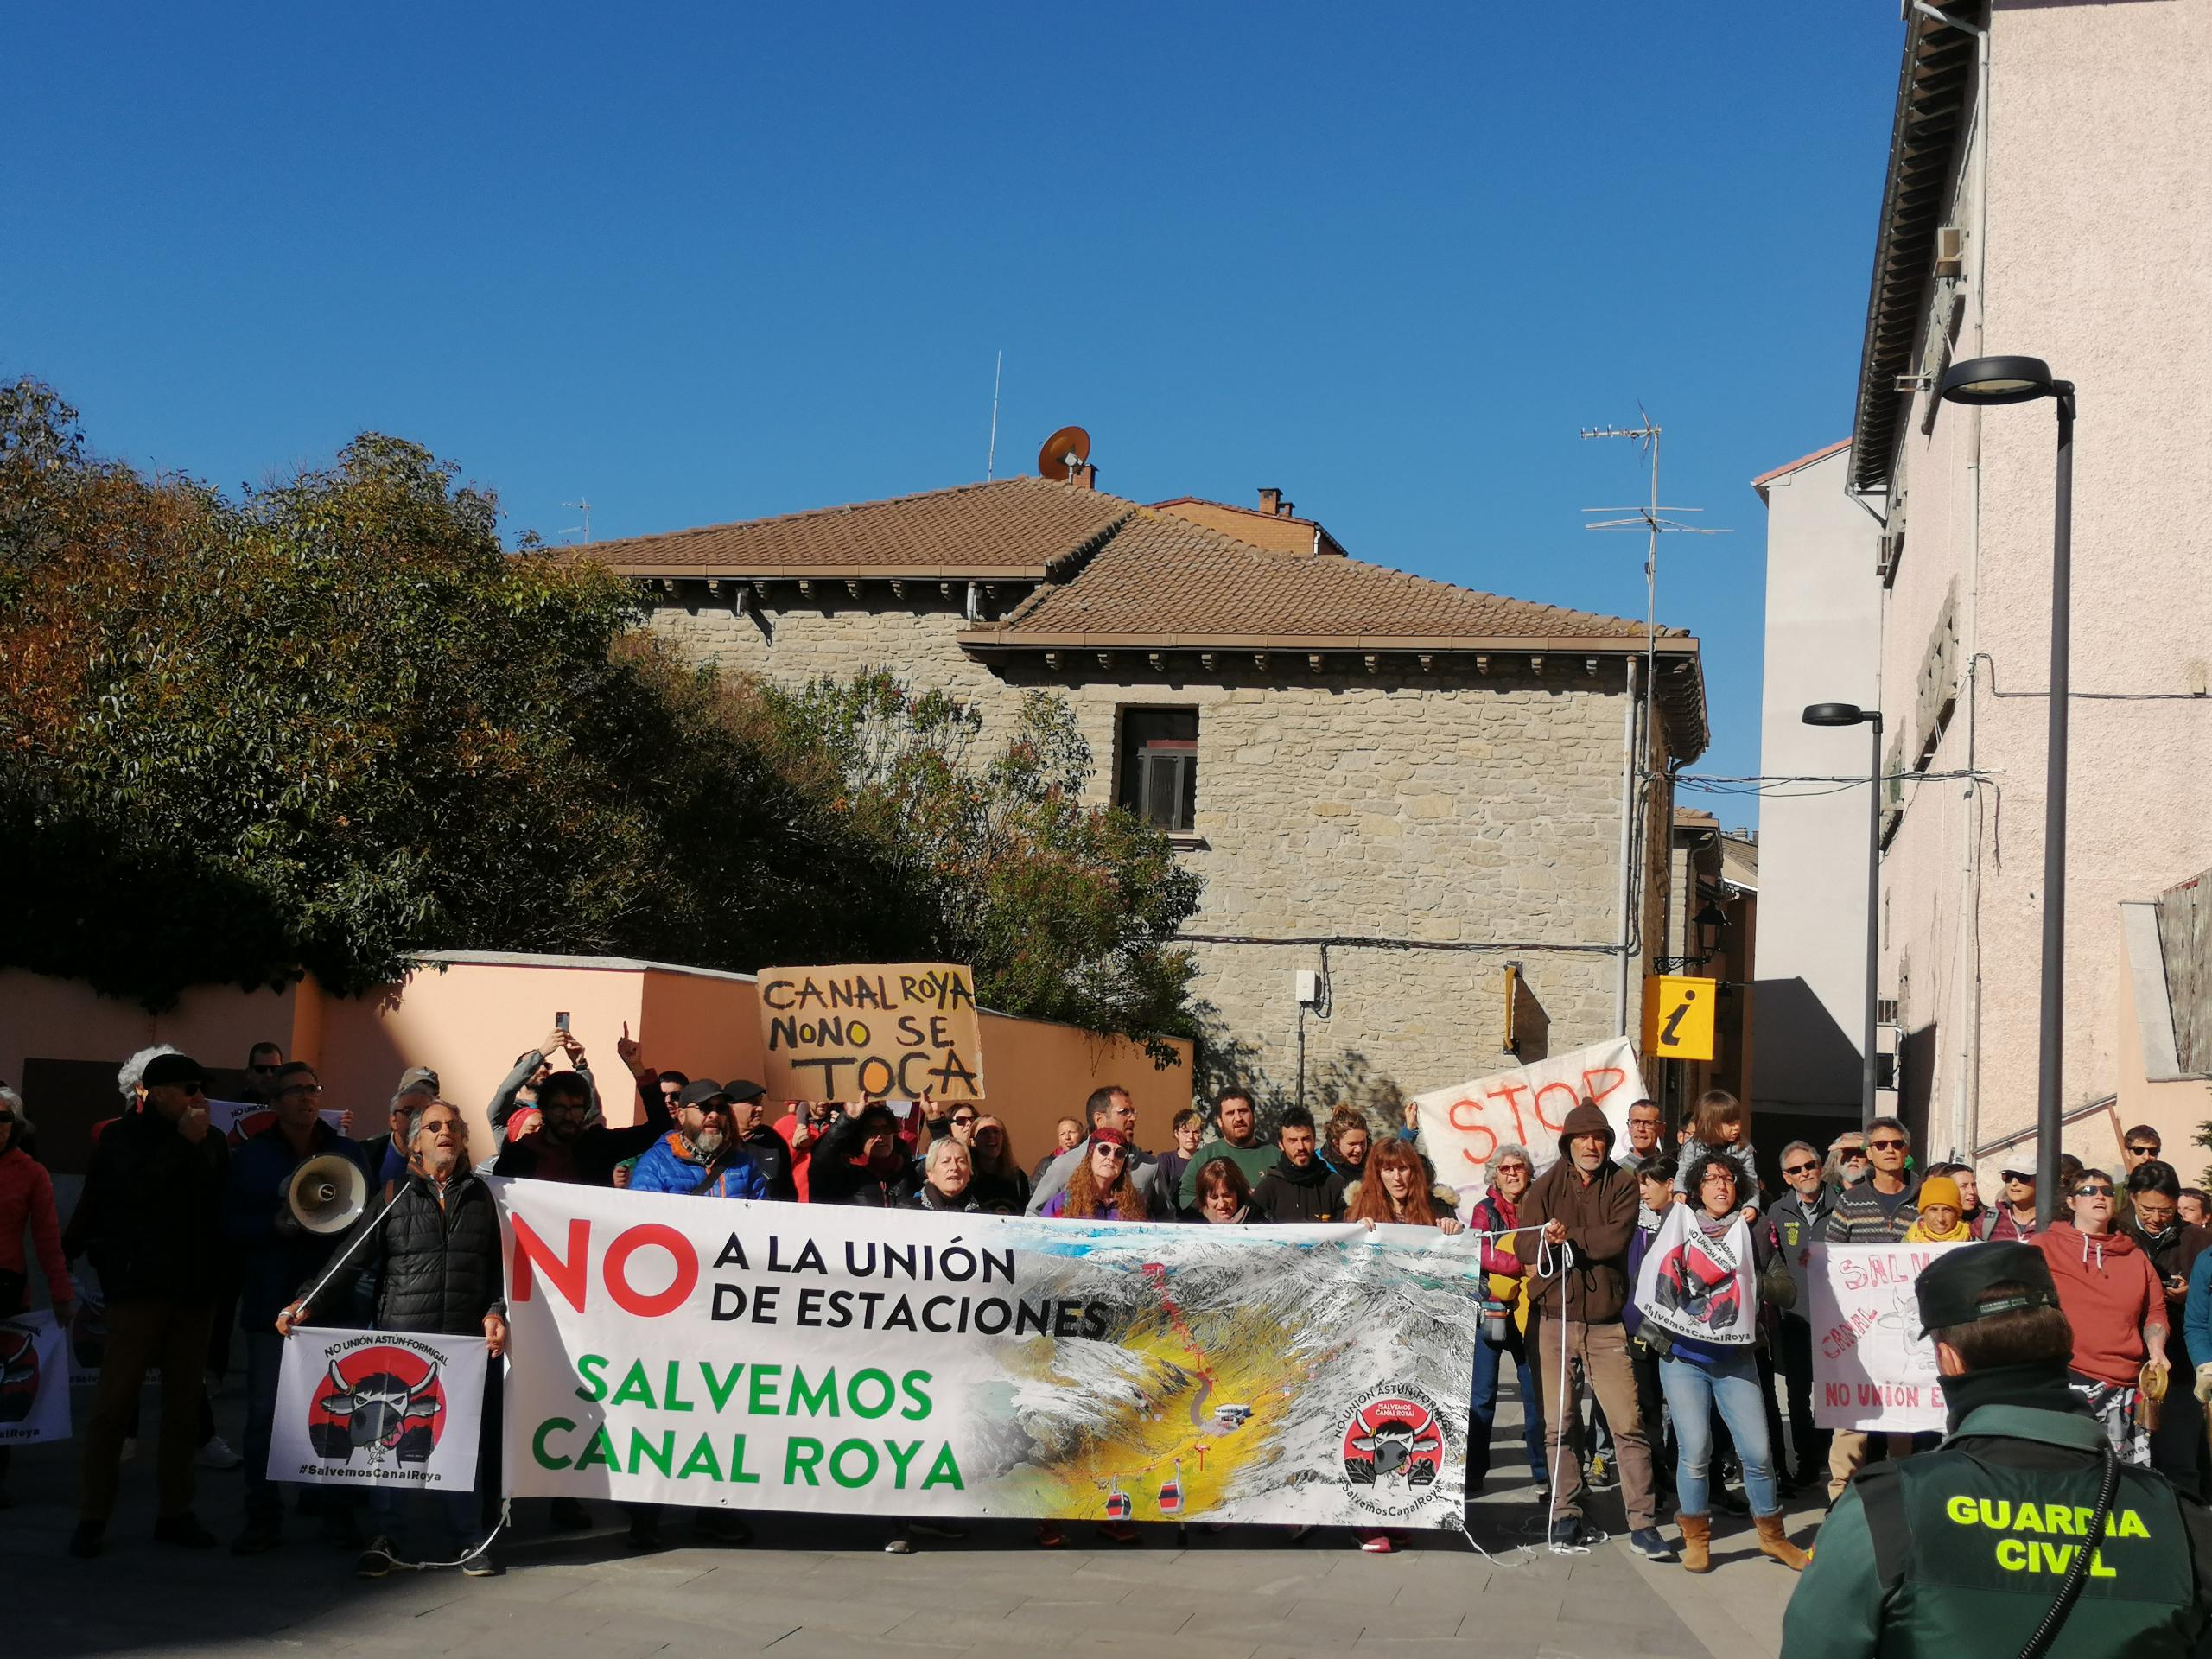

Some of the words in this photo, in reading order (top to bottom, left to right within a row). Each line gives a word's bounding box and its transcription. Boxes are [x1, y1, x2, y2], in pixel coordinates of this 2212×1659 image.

[764, 975, 898, 1010] CANAL
[899, 970, 976, 1010] ROYA
[896, 1015, 954, 1048] SE
[791, 1049, 978, 1100] TOCA
[1449, 1067, 1625, 1165] STOP
[512, 1212, 699, 1318] NO
[713, 1231, 750, 1270] A
[768, 1236, 829, 1275] LA
[845, 1236, 1016, 1285] UNIÓN
[711, 1282, 780, 1324] DE
[797, 1287, 1108, 1338] ESTACIONES
[1822, 1307, 1878, 1359] CANAL
[324, 1344, 341, 1359] NO
[343, 1334, 374, 1351] UNIÓN
[575, 1354, 933, 1421] SALVEMOS
[1826, 1382, 1851, 1407] NO
[1858, 1381, 1919, 1408] UNIÓN
[532, 1416, 760, 1484] CANAL
[783, 1436, 965, 1491] ROYA
[1334, 1420, 1346, 1439] NO
[298, 1465, 442, 1483] #SalvemosCanalRoya
[1947, 1496, 2151, 1538] GUARDIA
